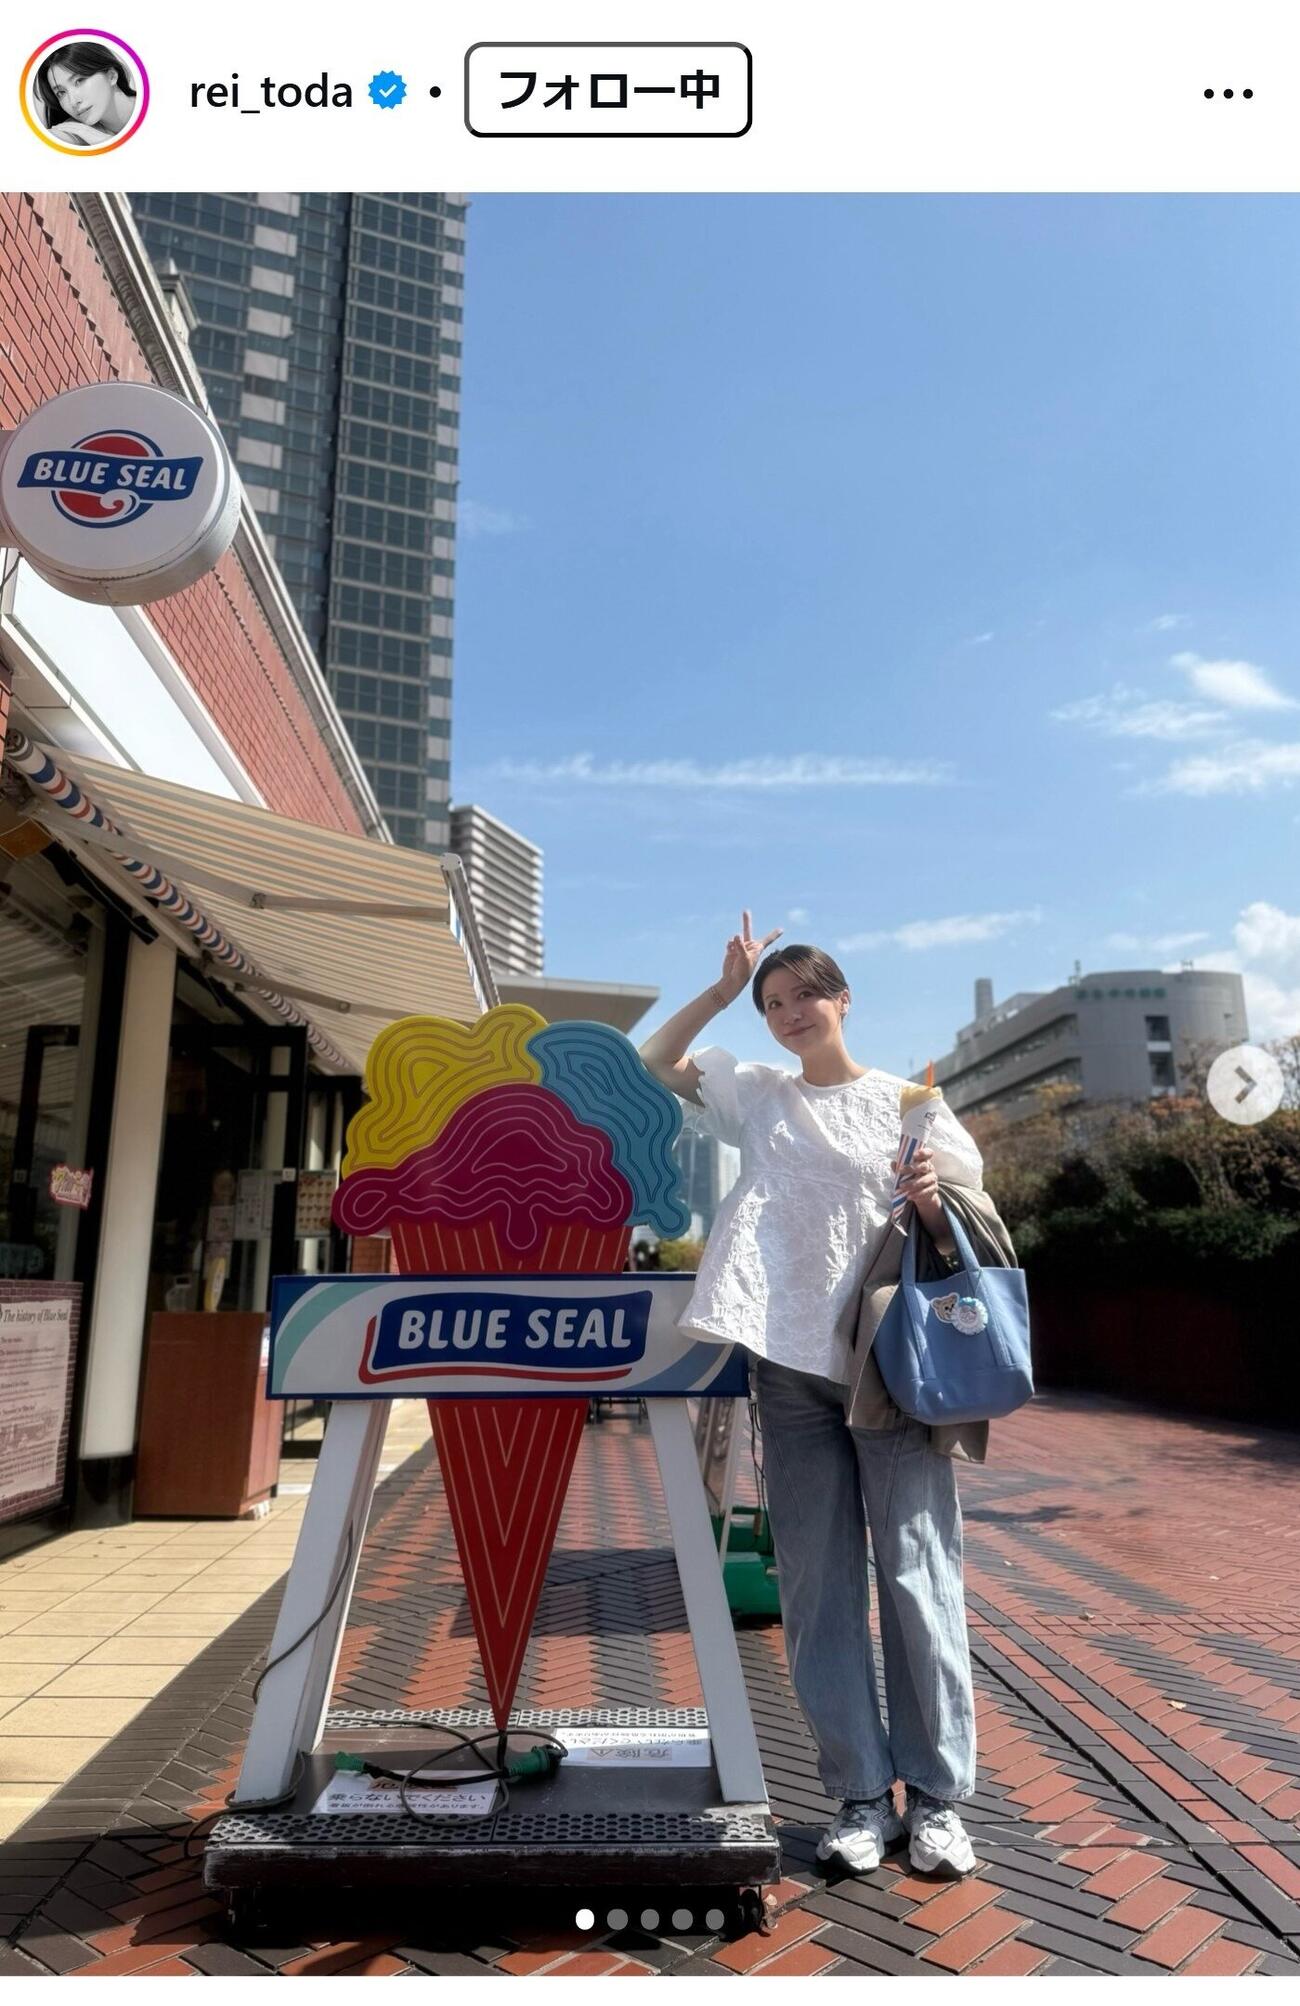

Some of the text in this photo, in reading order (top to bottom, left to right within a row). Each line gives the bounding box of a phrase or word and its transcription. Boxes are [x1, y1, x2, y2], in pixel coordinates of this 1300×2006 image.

[34, 457, 188, 491] BLUE SEAL
[3, 1308, 16, 1322] The
[17, 1308, 37, 1323] history
[398, 1307, 631, 1350] BLUE SEAL
